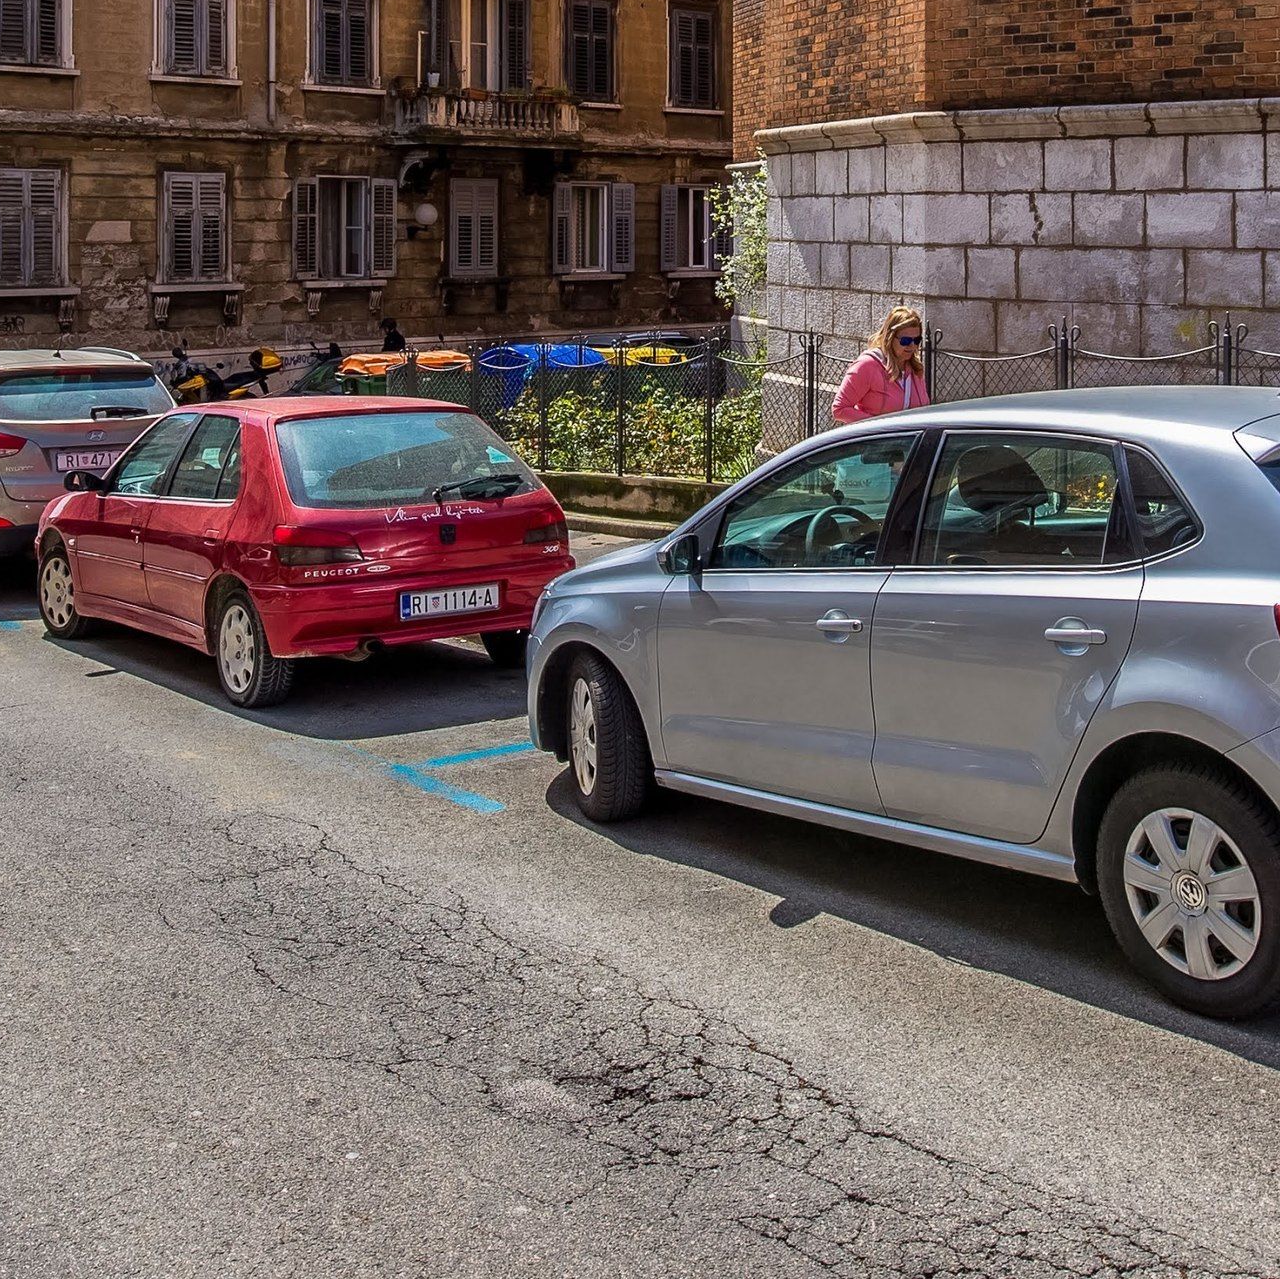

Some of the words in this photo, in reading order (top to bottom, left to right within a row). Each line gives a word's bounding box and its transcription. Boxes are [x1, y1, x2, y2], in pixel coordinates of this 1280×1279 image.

[66, 455, 80, 467] RI
[90, 452, 119, 466] 471-
[304, 568, 360, 578] PEUGEOT
[412, 595, 428, 614] RI
[444, 588, 493, 611] 1114-A
